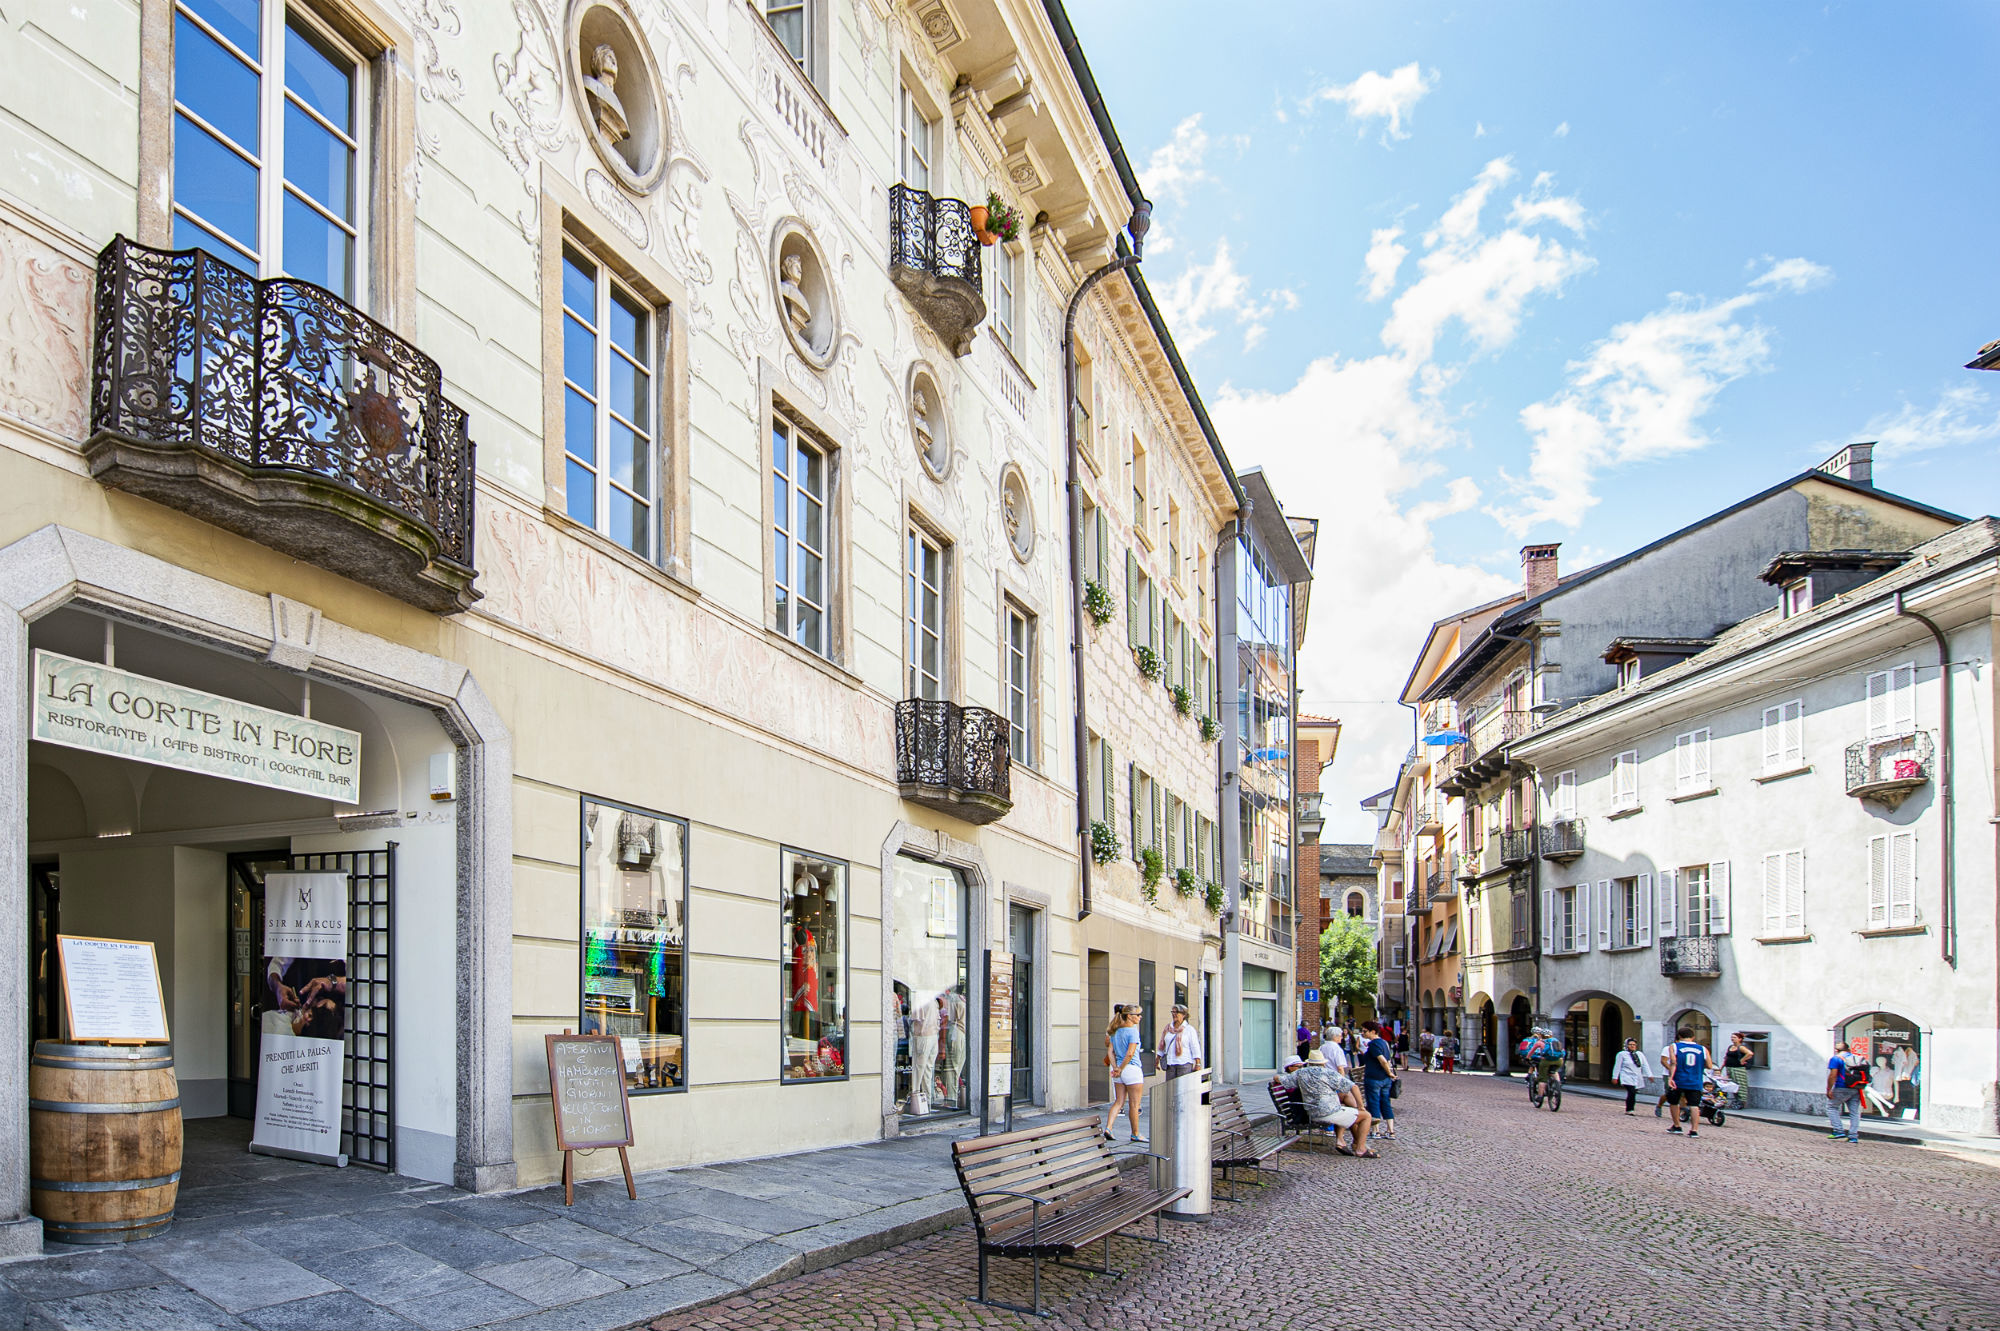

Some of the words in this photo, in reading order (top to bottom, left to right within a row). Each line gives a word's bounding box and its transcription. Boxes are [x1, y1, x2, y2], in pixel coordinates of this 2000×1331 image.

[47, 674, 94, 707] LA
[109, 691, 221, 735] CORTE
[232, 719, 262, 746] IN
[273, 729, 354, 766] FIORE
[47, 711, 147, 742] RISTORANTE
[203, 745, 259, 767] BISTROT
[269, 760, 325, 782] COCKTAIL
[328, 772, 351, 786] BAR
[268, 919, 287, 928] SIR
[295, 919, 342, 929] MARCUS
[265, 1051, 295, 1062] PRENDITI
[296, 1049, 306, 1059] LA
[307, 1046, 332, 1057] PAUSA
[281, 1064, 294, 1075] CHE
[295, 1062, 319, 1073] MERITI
